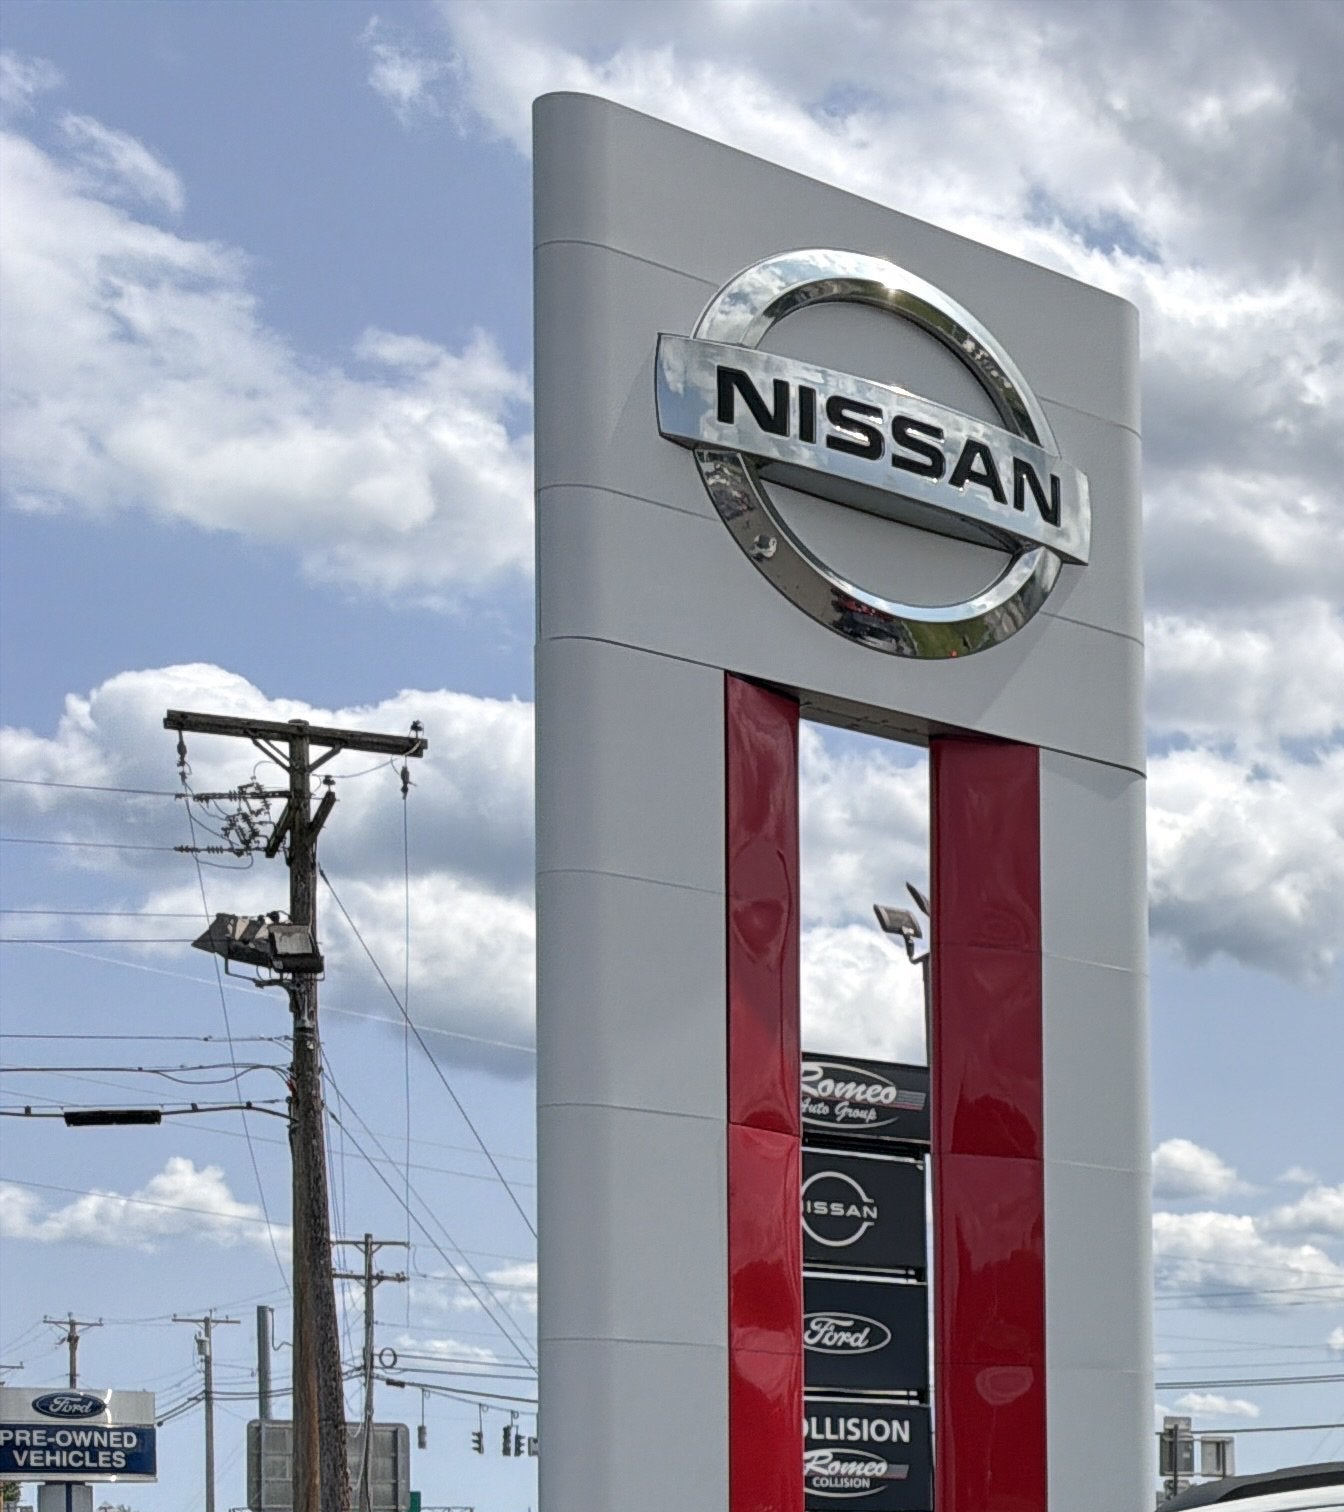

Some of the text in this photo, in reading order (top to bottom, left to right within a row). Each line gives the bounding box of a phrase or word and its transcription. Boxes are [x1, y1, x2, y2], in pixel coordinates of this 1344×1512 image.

[716, 364, 1062, 528] NISSAN
[835, 1101, 878, 1123] Group
[803, 1200, 878, 1219] ISSAN
[804, 1318, 871, 1348] Ford
[49, 1396, 93, 1414] Ford
[0, 1429, 138, 1449] PRE-OWNED
[803, 1417, 910, 1443] LLISION
[12, 1450, 127, 1469] VEHICLES
[804, 1451, 888, 1478] Romeo
[812, 1477, 871, 1489] COLLISION
